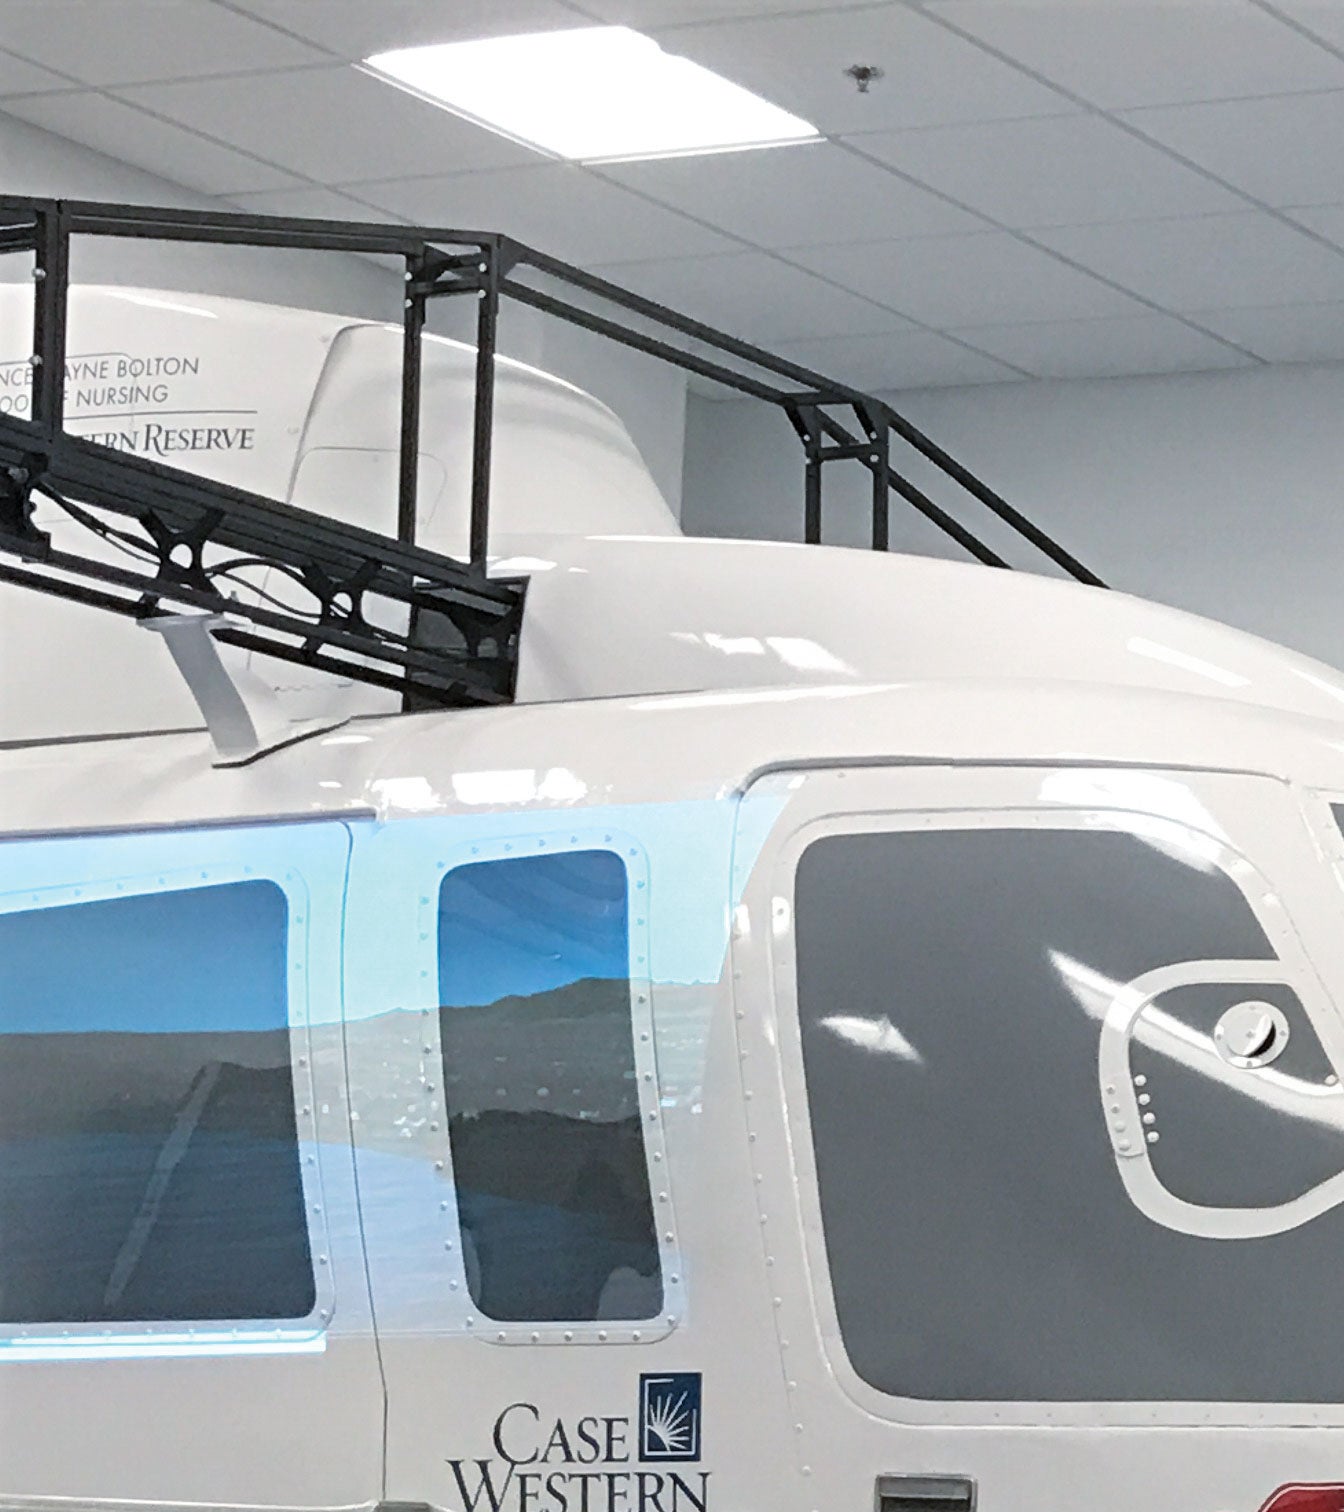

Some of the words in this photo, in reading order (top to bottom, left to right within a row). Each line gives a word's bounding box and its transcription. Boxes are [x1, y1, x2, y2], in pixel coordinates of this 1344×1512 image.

[117, 357, 199, 378] BOLTON
[76, 384, 169, 408] NURSING
[143, 423, 256, 457] RESERVE
[492, 1402, 631, 1465] CASE
